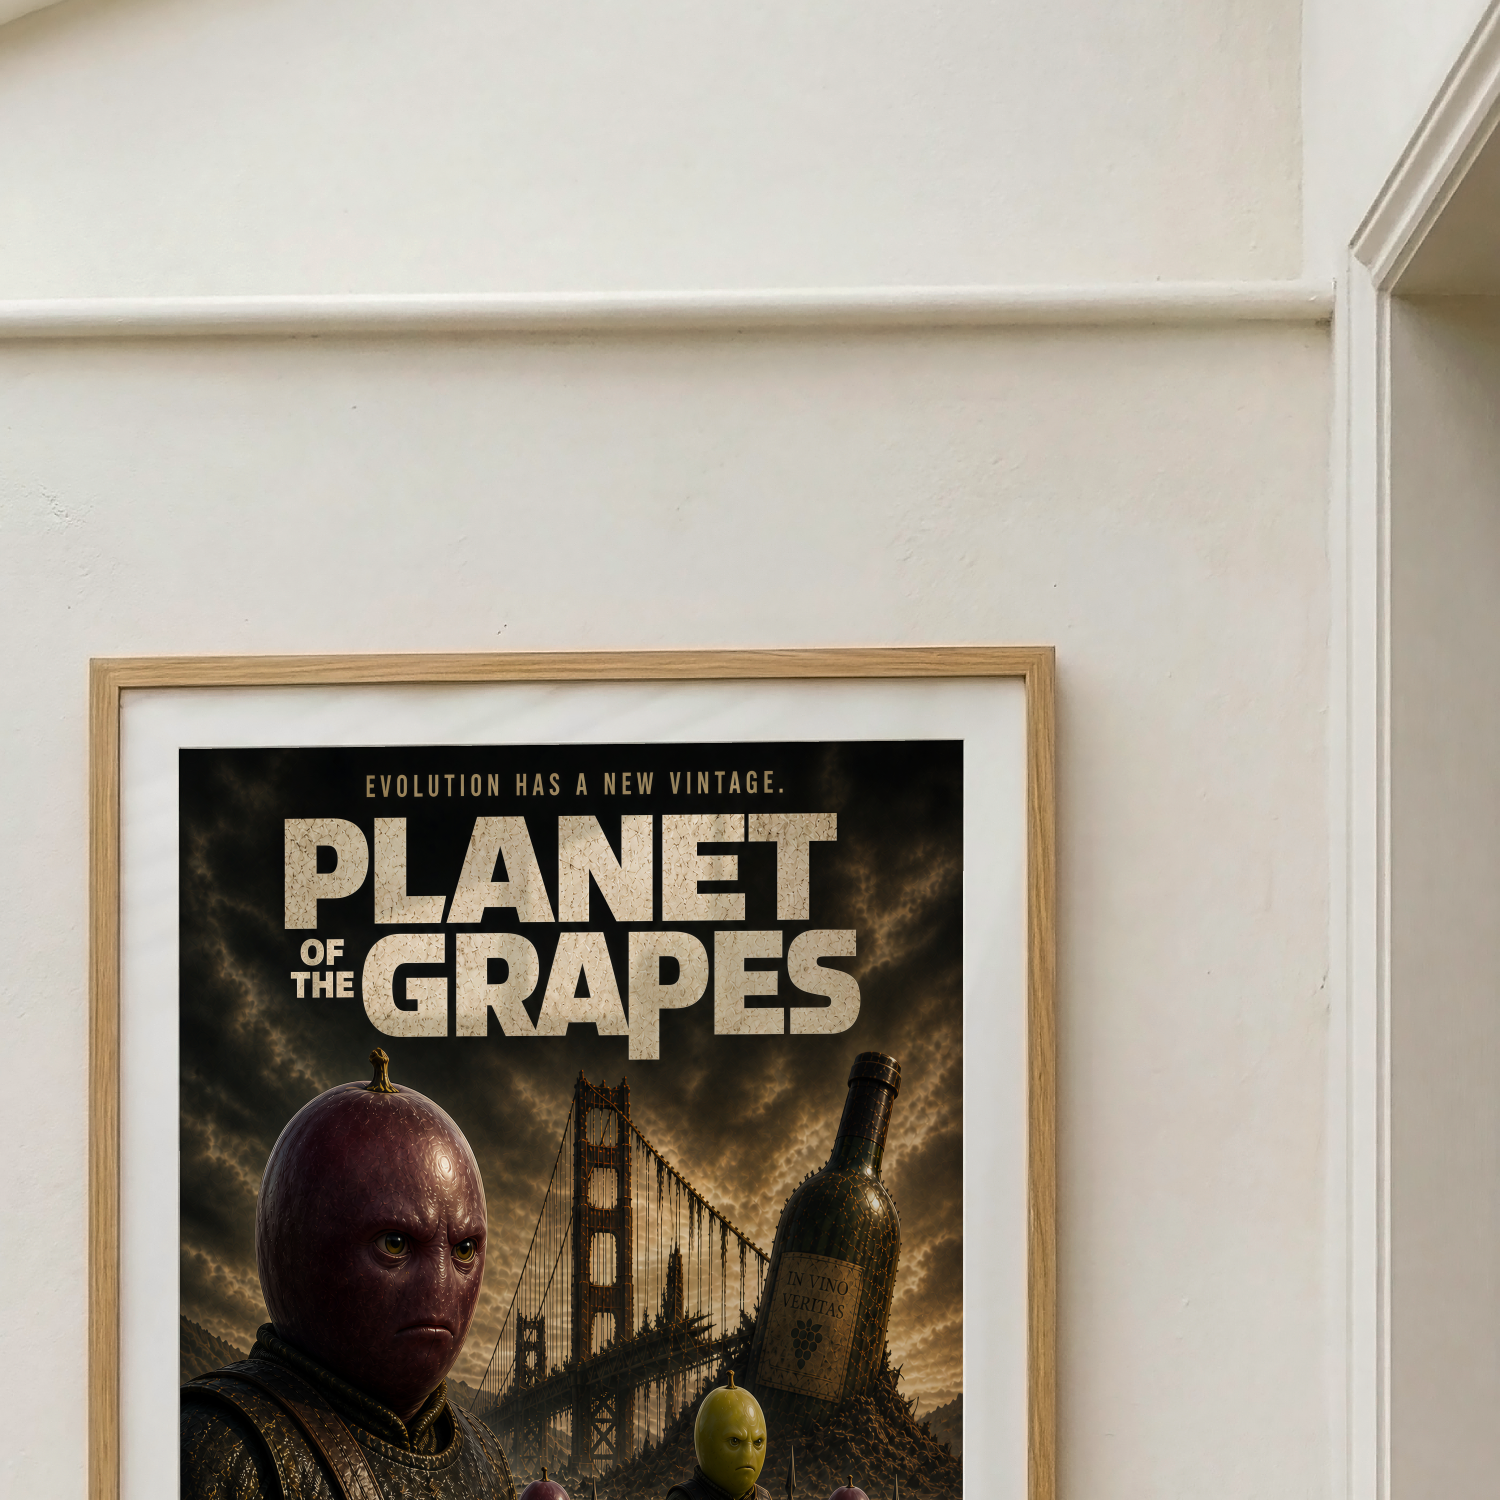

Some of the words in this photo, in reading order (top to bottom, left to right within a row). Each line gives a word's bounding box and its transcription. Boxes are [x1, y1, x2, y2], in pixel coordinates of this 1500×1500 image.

[366, 773, 500, 798] EVOLUTION
[516, 772, 561, 797] HAS
[575, 772, 589, 796] A
[604, 771, 655, 795] NEW
[669, 770, 785, 795] VINTAGE.
[284, 812, 838, 929] PLANET
[300, 938, 345, 967] OF
[290, 970, 355, 999] THE
[361, 929, 861, 1061] GRAPES
[787, 1270, 805, 1287] IN
[809, 1274, 849, 1296] VINO
[782, 1292, 845, 1319] VERITAS
